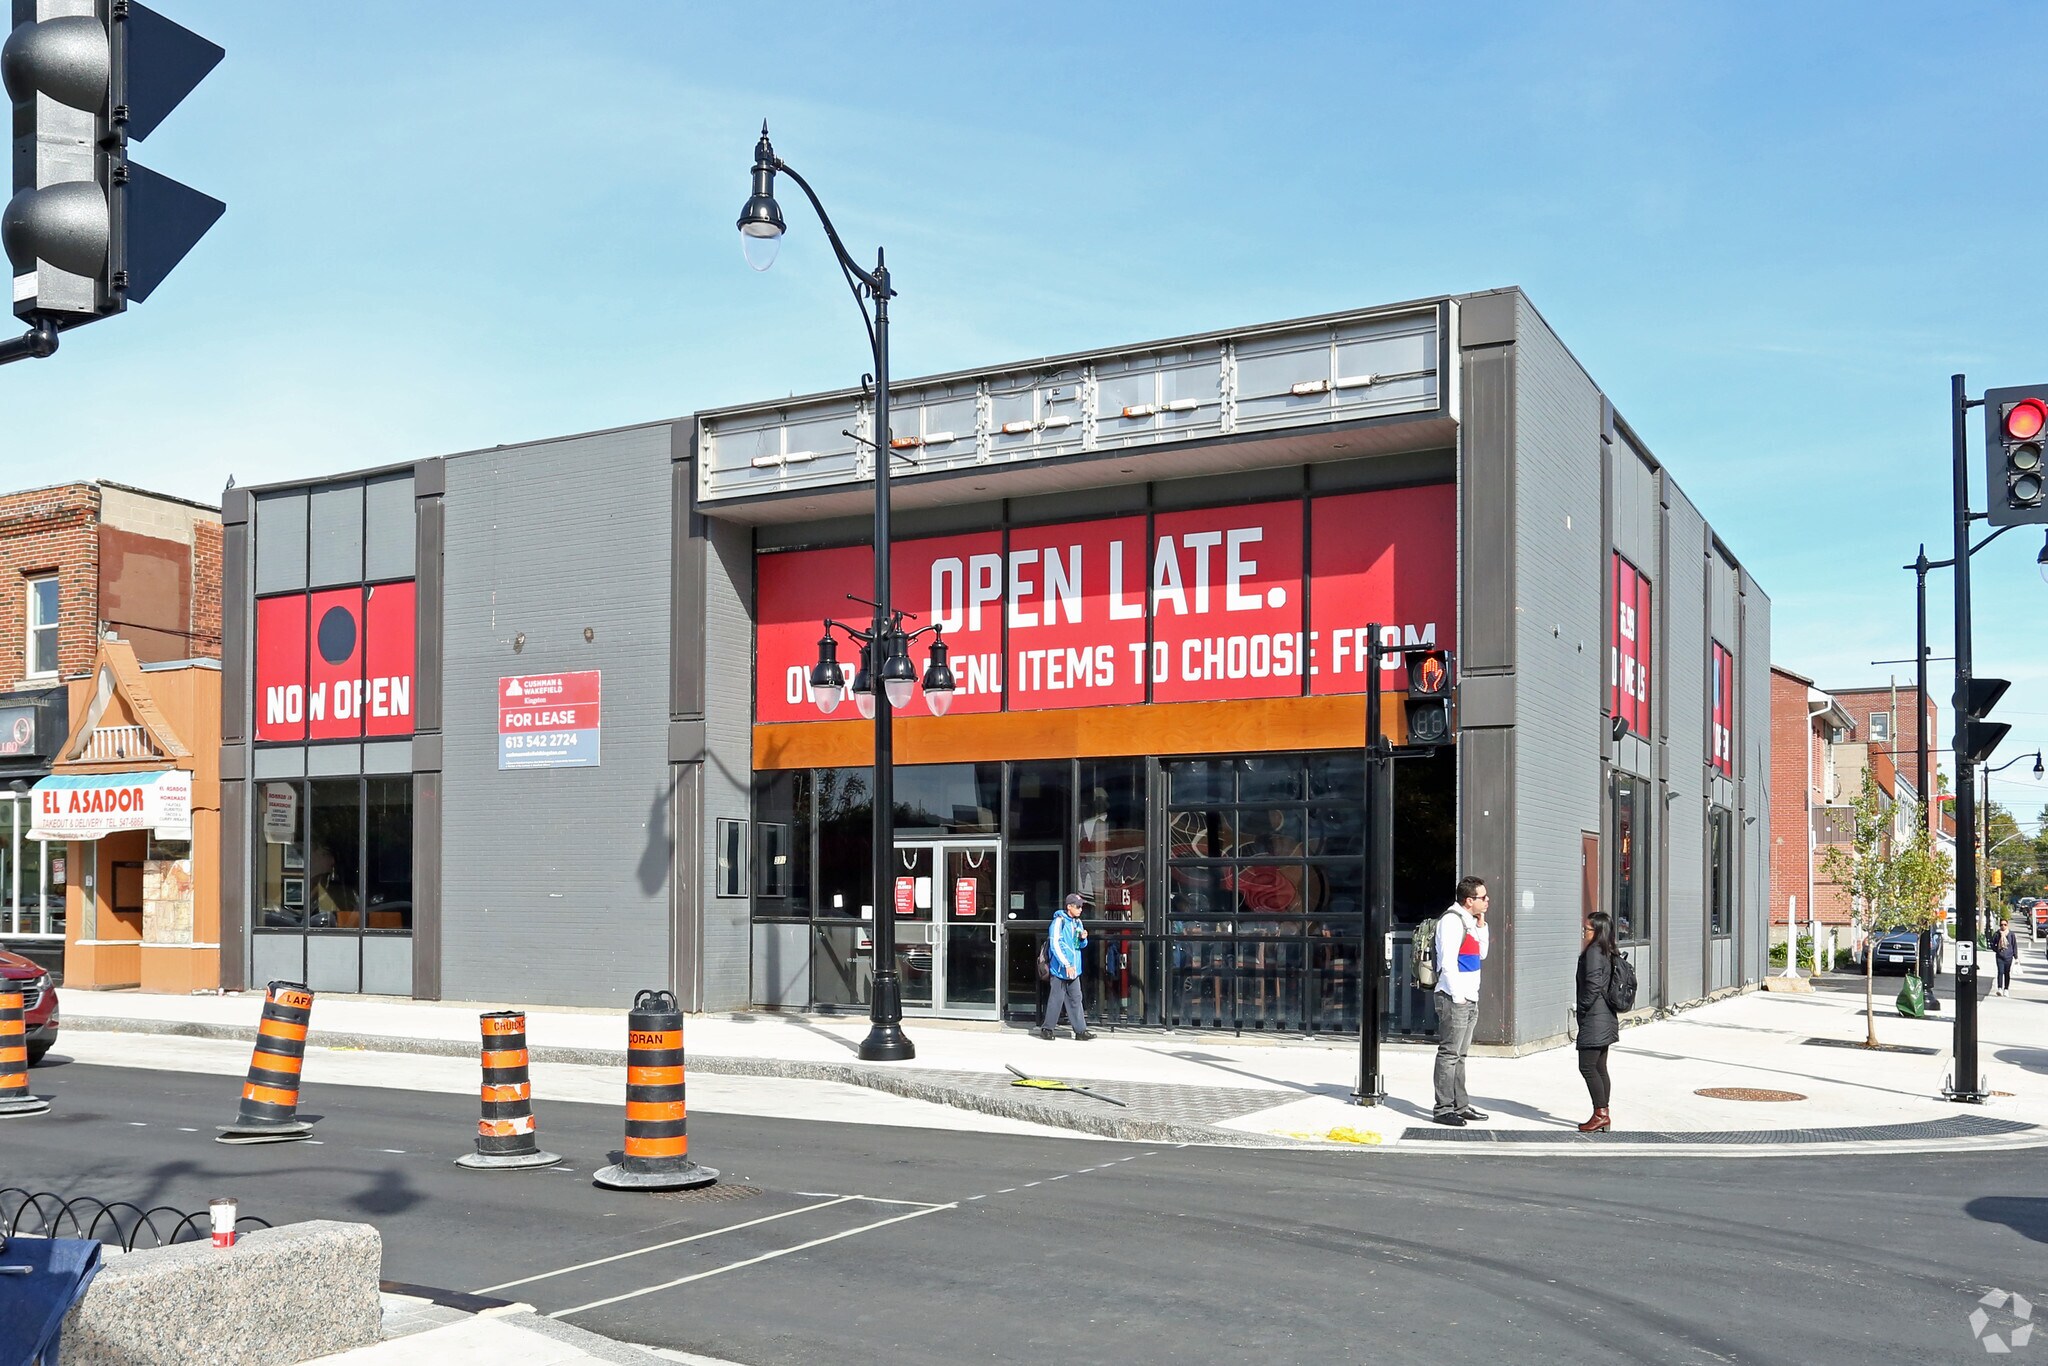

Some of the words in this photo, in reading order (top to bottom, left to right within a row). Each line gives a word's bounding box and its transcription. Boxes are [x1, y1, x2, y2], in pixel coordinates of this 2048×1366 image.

[930, 545, 1082, 633] OPEN
[1110, 527, 1287, 620] LATE.
[923, 652, 1002, 697] ENU
[1018, 645, 1114, 692] ITEMS
[1129, 640, 1169, 685] TO
[1182, 630, 1319, 682] CHOOSE
[524, 679, 556, 688] CUSHMAN
[524, 686, 563, 695] WAKEFIELD
[267, 682, 327, 725] NOW
[333, 676, 410, 720] OPEN
[505, 713, 532, 727] FOR
[535, 710, 576, 726] LEASE
[505, 736, 524, 749] 613
[526, 734, 547, 747] 542
[549, 733, 578, 747] 2724
[43, 791, 60, 814] EL
[68, 788, 144, 814] ASADOR
[42, 818, 69, 828] TAKEOUT
[74, 817, 102, 828] DELIVERY
